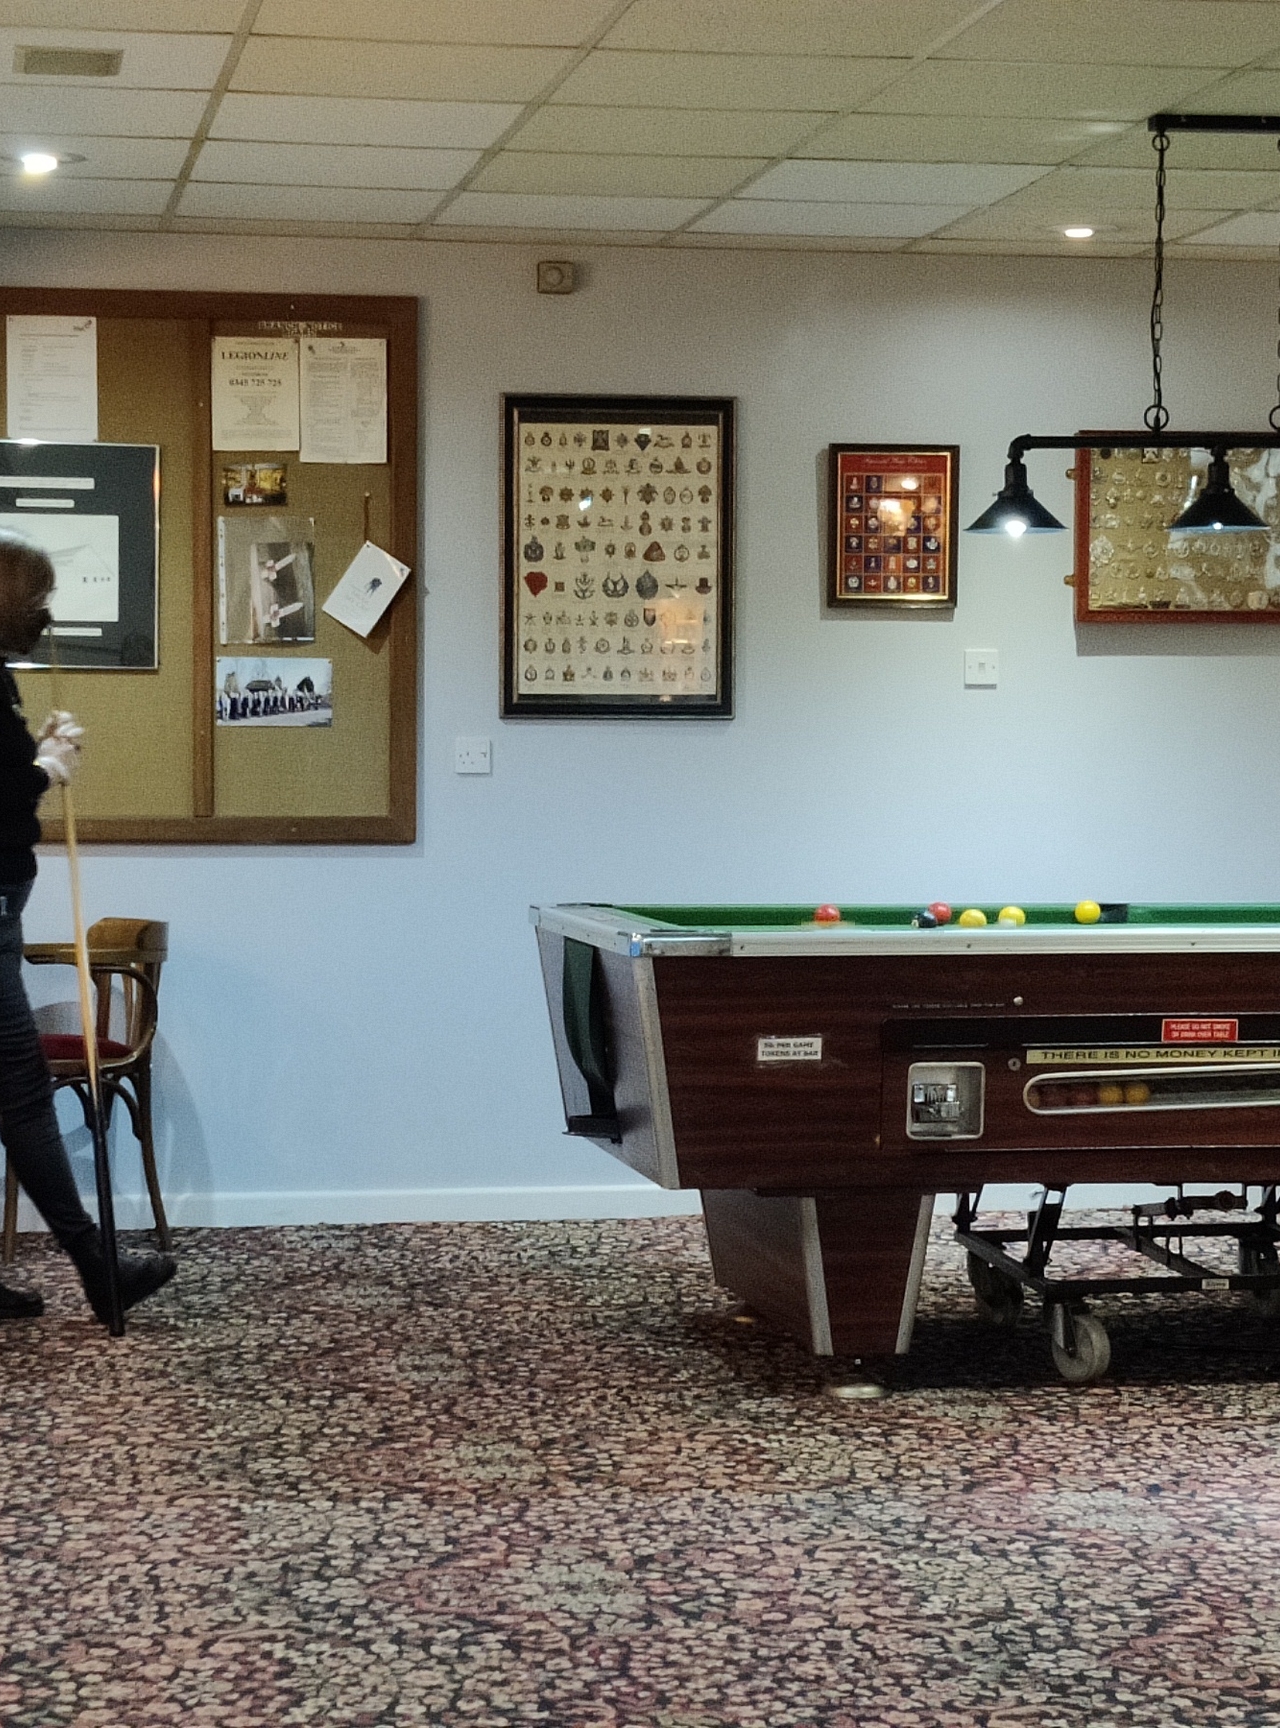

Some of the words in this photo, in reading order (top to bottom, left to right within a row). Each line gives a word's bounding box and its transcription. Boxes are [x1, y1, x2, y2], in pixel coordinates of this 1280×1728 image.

[221, 351, 290, 361] LEGIONLINE
[1042, 1051, 1098, 1060] THERE
[1104, 1051, 1120, 1059] IS
[1125, 1050, 1150, 1059] NO
[1156, 1050, 1218, 1058] MONEY
[1223, 1049, 1268, 1058] KEPT
